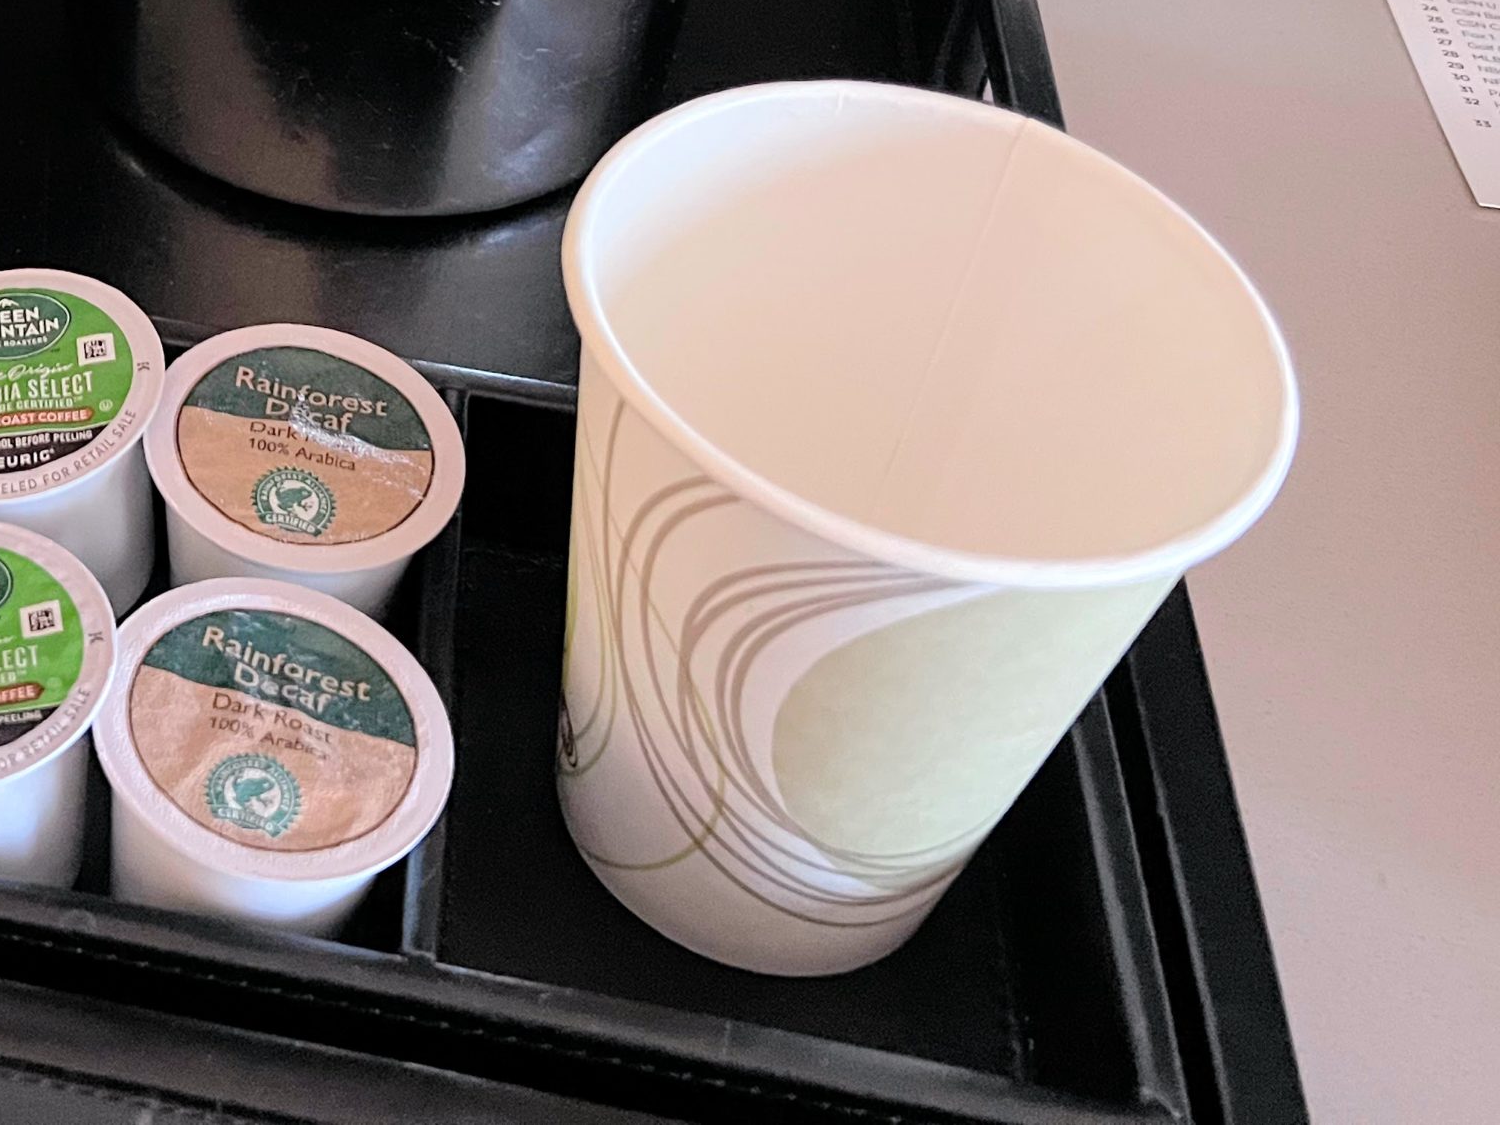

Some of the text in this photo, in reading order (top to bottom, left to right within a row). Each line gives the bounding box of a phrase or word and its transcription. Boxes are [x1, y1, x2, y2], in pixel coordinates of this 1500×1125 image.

[3, 335, 48, 347] ROASTERS
[7, 362, 73, 381] Origin
[27, 370, 93, 400] SELECT
[235, 366, 388, 416] Rainforest
[37, 409, 89, 422] COFFEE
[250, 421, 297, 441] Dark
[15, 432, 51, 448] BEFORE
[53, 429, 93, 444] PEELING
[43, 466, 71, 486] FOR
[73, 437, 115, 472] RETAIL
[112, 410, 137, 438] SALE
[248, 437, 290, 456] 100%
[295, 447, 356, 471] Arabica
[202, 626, 371, 702] Rainforest
[65, 687, 91, 721] SALE
[234, 661, 332, 714] Decaf
[212, 692, 332, 744] Dark Roast
[209, 716, 330, 761] 100% Arabica
